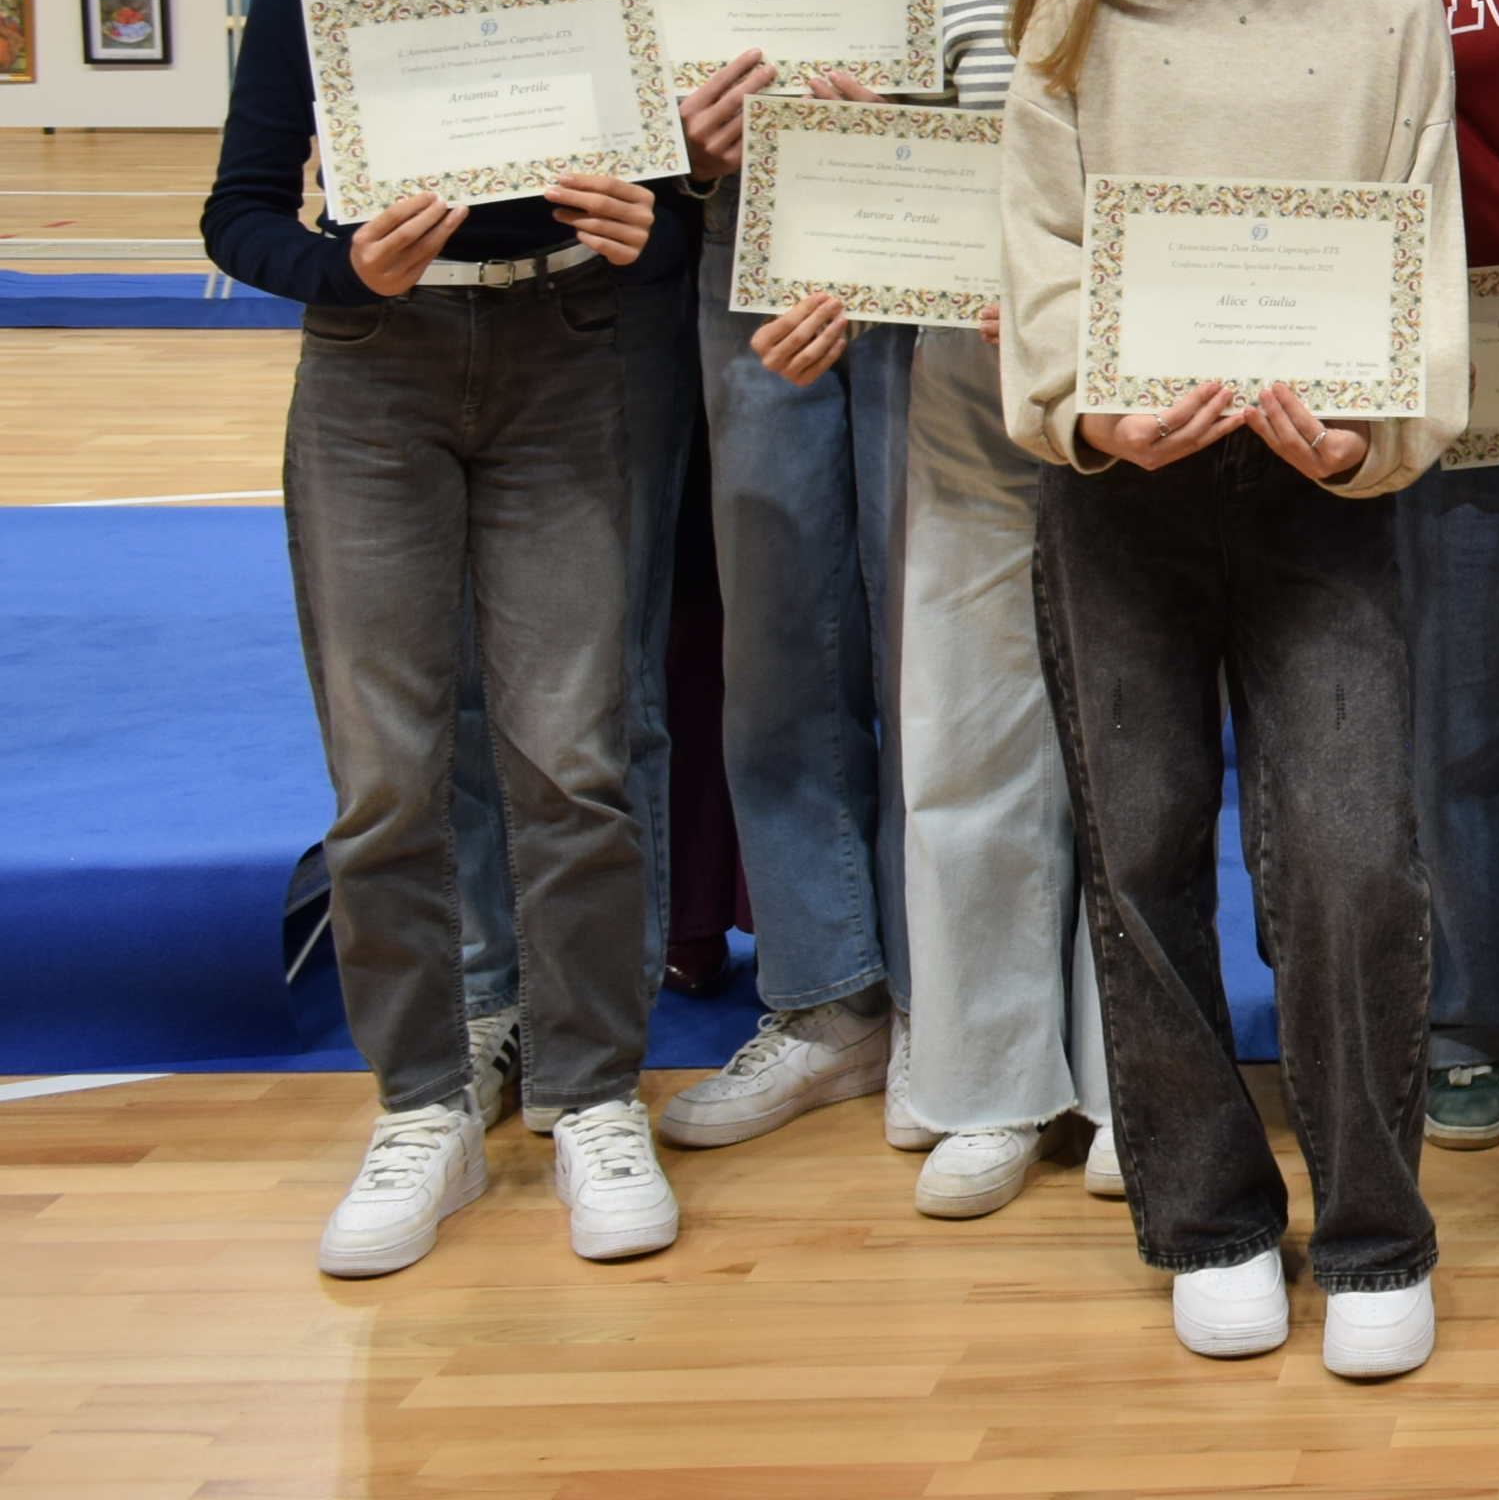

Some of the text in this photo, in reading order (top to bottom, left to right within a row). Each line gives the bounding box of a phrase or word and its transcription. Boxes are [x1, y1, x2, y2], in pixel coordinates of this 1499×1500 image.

[448, 81, 551, 103] Arianna Pertile
[854, 209, 941, 225] Aurora Pertile
[1232, 245, 1249, 253] Don
[1251, 245, 1276, 253] Dante
[1323, 247, 1340, 255] ETS
[1216, 295, 1297, 307] Alice Giulia
